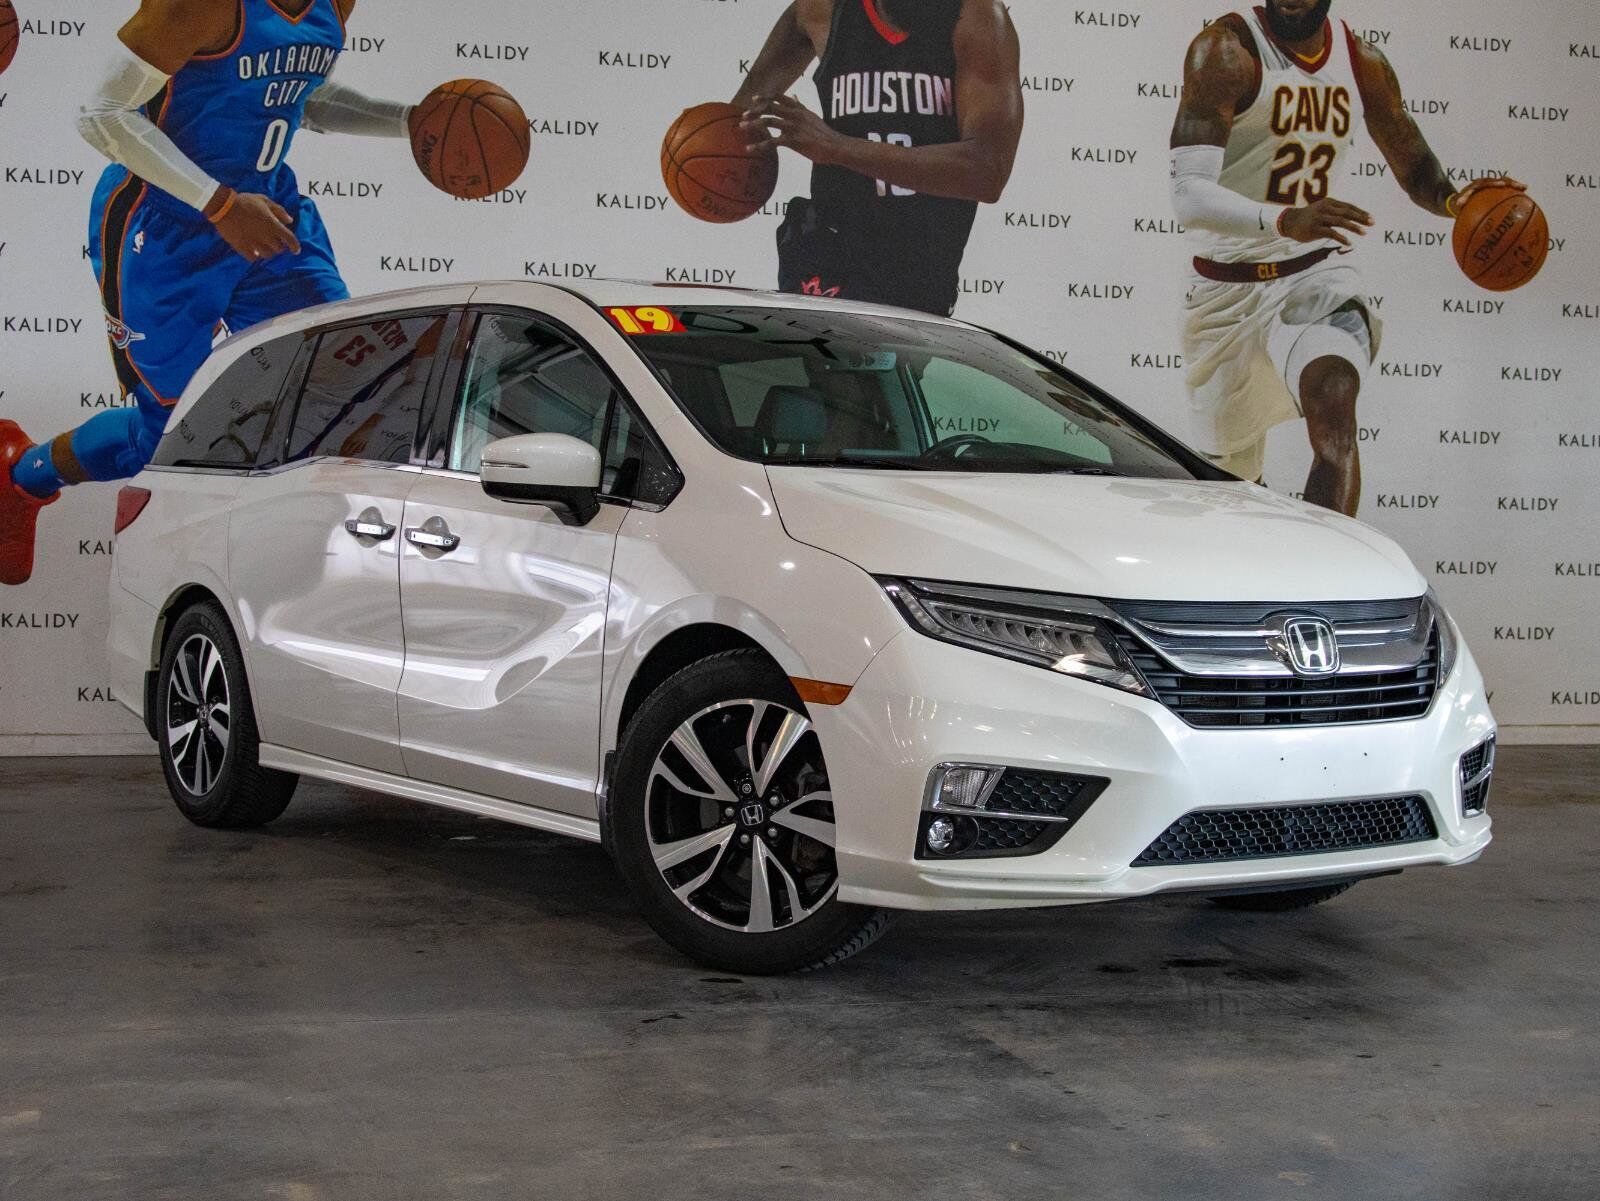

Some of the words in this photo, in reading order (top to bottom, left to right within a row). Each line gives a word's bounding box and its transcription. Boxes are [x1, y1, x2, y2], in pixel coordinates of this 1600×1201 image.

[1075, 11, 1140, 27] KALIDY
[22, 19, 85, 36] ALIDY
[346, 37, 385, 53] IDY
[457, 43, 528, 60] KALIDY
[1451, 36, 1511, 52] KALIDY
[1569, 44, 1600, 58] KAL
[239, 45, 335, 79] OKLAHOM
[600, 51, 670, 68] KALIDY
[1021, 77, 1074, 92] ALIDY
[1138, 83, 1183, 98] KALI
[264, 80, 309, 107] CITY
[831, 71, 953, 119] HOUSTON
[1271, 85, 1350, 138] CAVS
[1401, 99, 1449, 114] ALIDY
[1509, 105, 1568, 121] KALIDY
[528, 119, 599, 136] KALIDY
[256, 119, 289, 172] 0
[1072, 148, 1136, 163] KALIDY
[6, 168, 83, 184] KALIDY
[1265, 141, 1336, 206] 23
[1566, 174, 1598, 188] KAL
[308, 181, 383, 197] KALIDY
[597, 193, 668, 210] KALIDY
[1005, 213, 1070, 228] KALIDY
[1385, 231, 1446, 245] KALIDY
[381, 256, 453, 272] KALIDY
[525, 262, 597, 278] KALIDY
[1257, 264, 1278, 279] CLE
[666, 267, 736, 284] KALIDY
[1069, 284, 1133, 299] KALIDY
[1444, 299, 1504, 314] KALIDY
[1562, 304, 1600, 318] KALI
[5, 317, 81, 333] KALIDY
[609, 307, 674, 334] 19
[1131, 354, 1181, 369] KALID
[1381, 363, 1442, 377] KALIDY
[1502, 367, 1561, 381] KALIDY
[934, 416, 1000, 432] KALIDY
[1440, 430, 1500, 444] KALIDY
[1559, 433, 1600, 447] KALI
[1378, 495, 1438, 508] KALIDY
[1498, 497, 1558, 510] KALIDY
[1437, 561, 1497, 574] KALIDY
[1555, 563, 1600, 576] KALID
[2, 613, 79, 628] KALIDY
[1494, 627, 1554, 640] KALIDY
[77, 687, 116, 702] KAL
[1551, 691, 1600, 704] KALID
